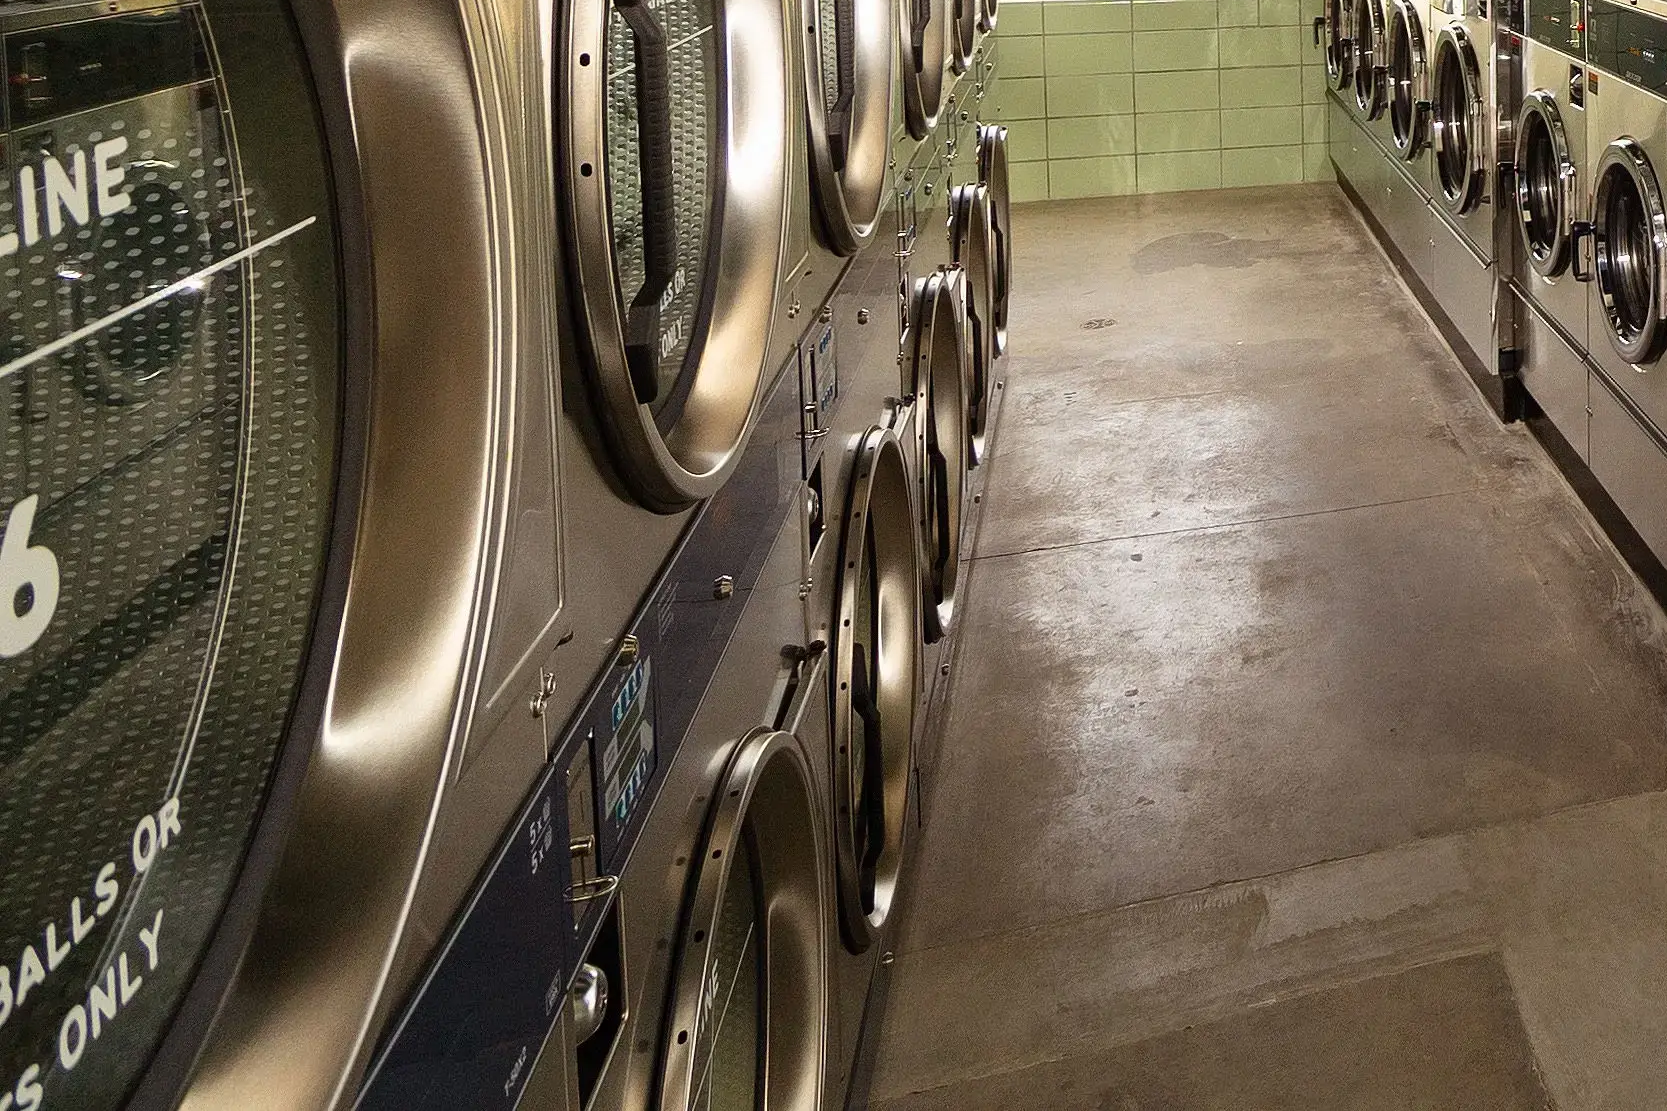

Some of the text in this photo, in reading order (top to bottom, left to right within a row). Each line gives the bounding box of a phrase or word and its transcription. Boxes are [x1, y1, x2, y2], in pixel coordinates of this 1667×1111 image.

[0, 135, 131, 258] INE
[132, 797, 182, 872] OR
[59, 908, 164, 1071] ONLY
